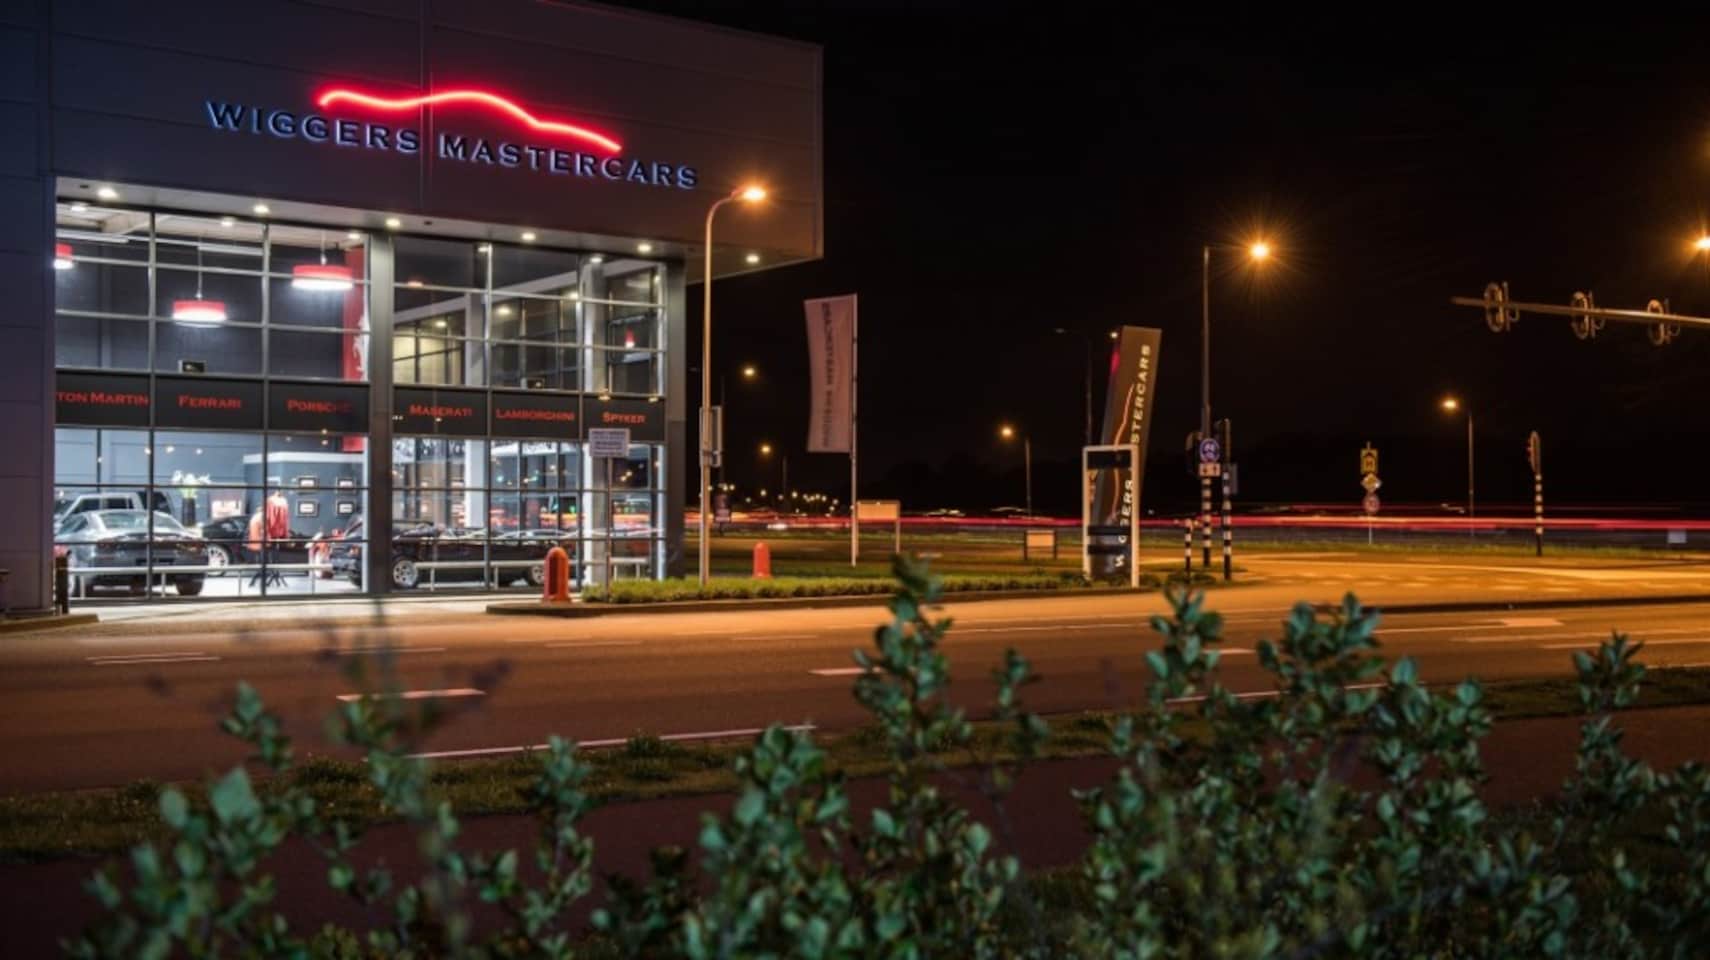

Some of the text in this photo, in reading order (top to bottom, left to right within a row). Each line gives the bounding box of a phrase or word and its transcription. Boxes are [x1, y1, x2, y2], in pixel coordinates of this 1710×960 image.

[206, 101, 699, 190] WIGGERS MASTERCARS
[90, 391, 149, 407] MARTIN
[1130, 344, 1151, 445] STERCARS
[178, 395, 242, 409] FERRARI
[409, 403, 473, 417] MASERATI
[495, 408, 576, 422] LAMBORGHINI
[602, 411, 647, 424] SPYKER
